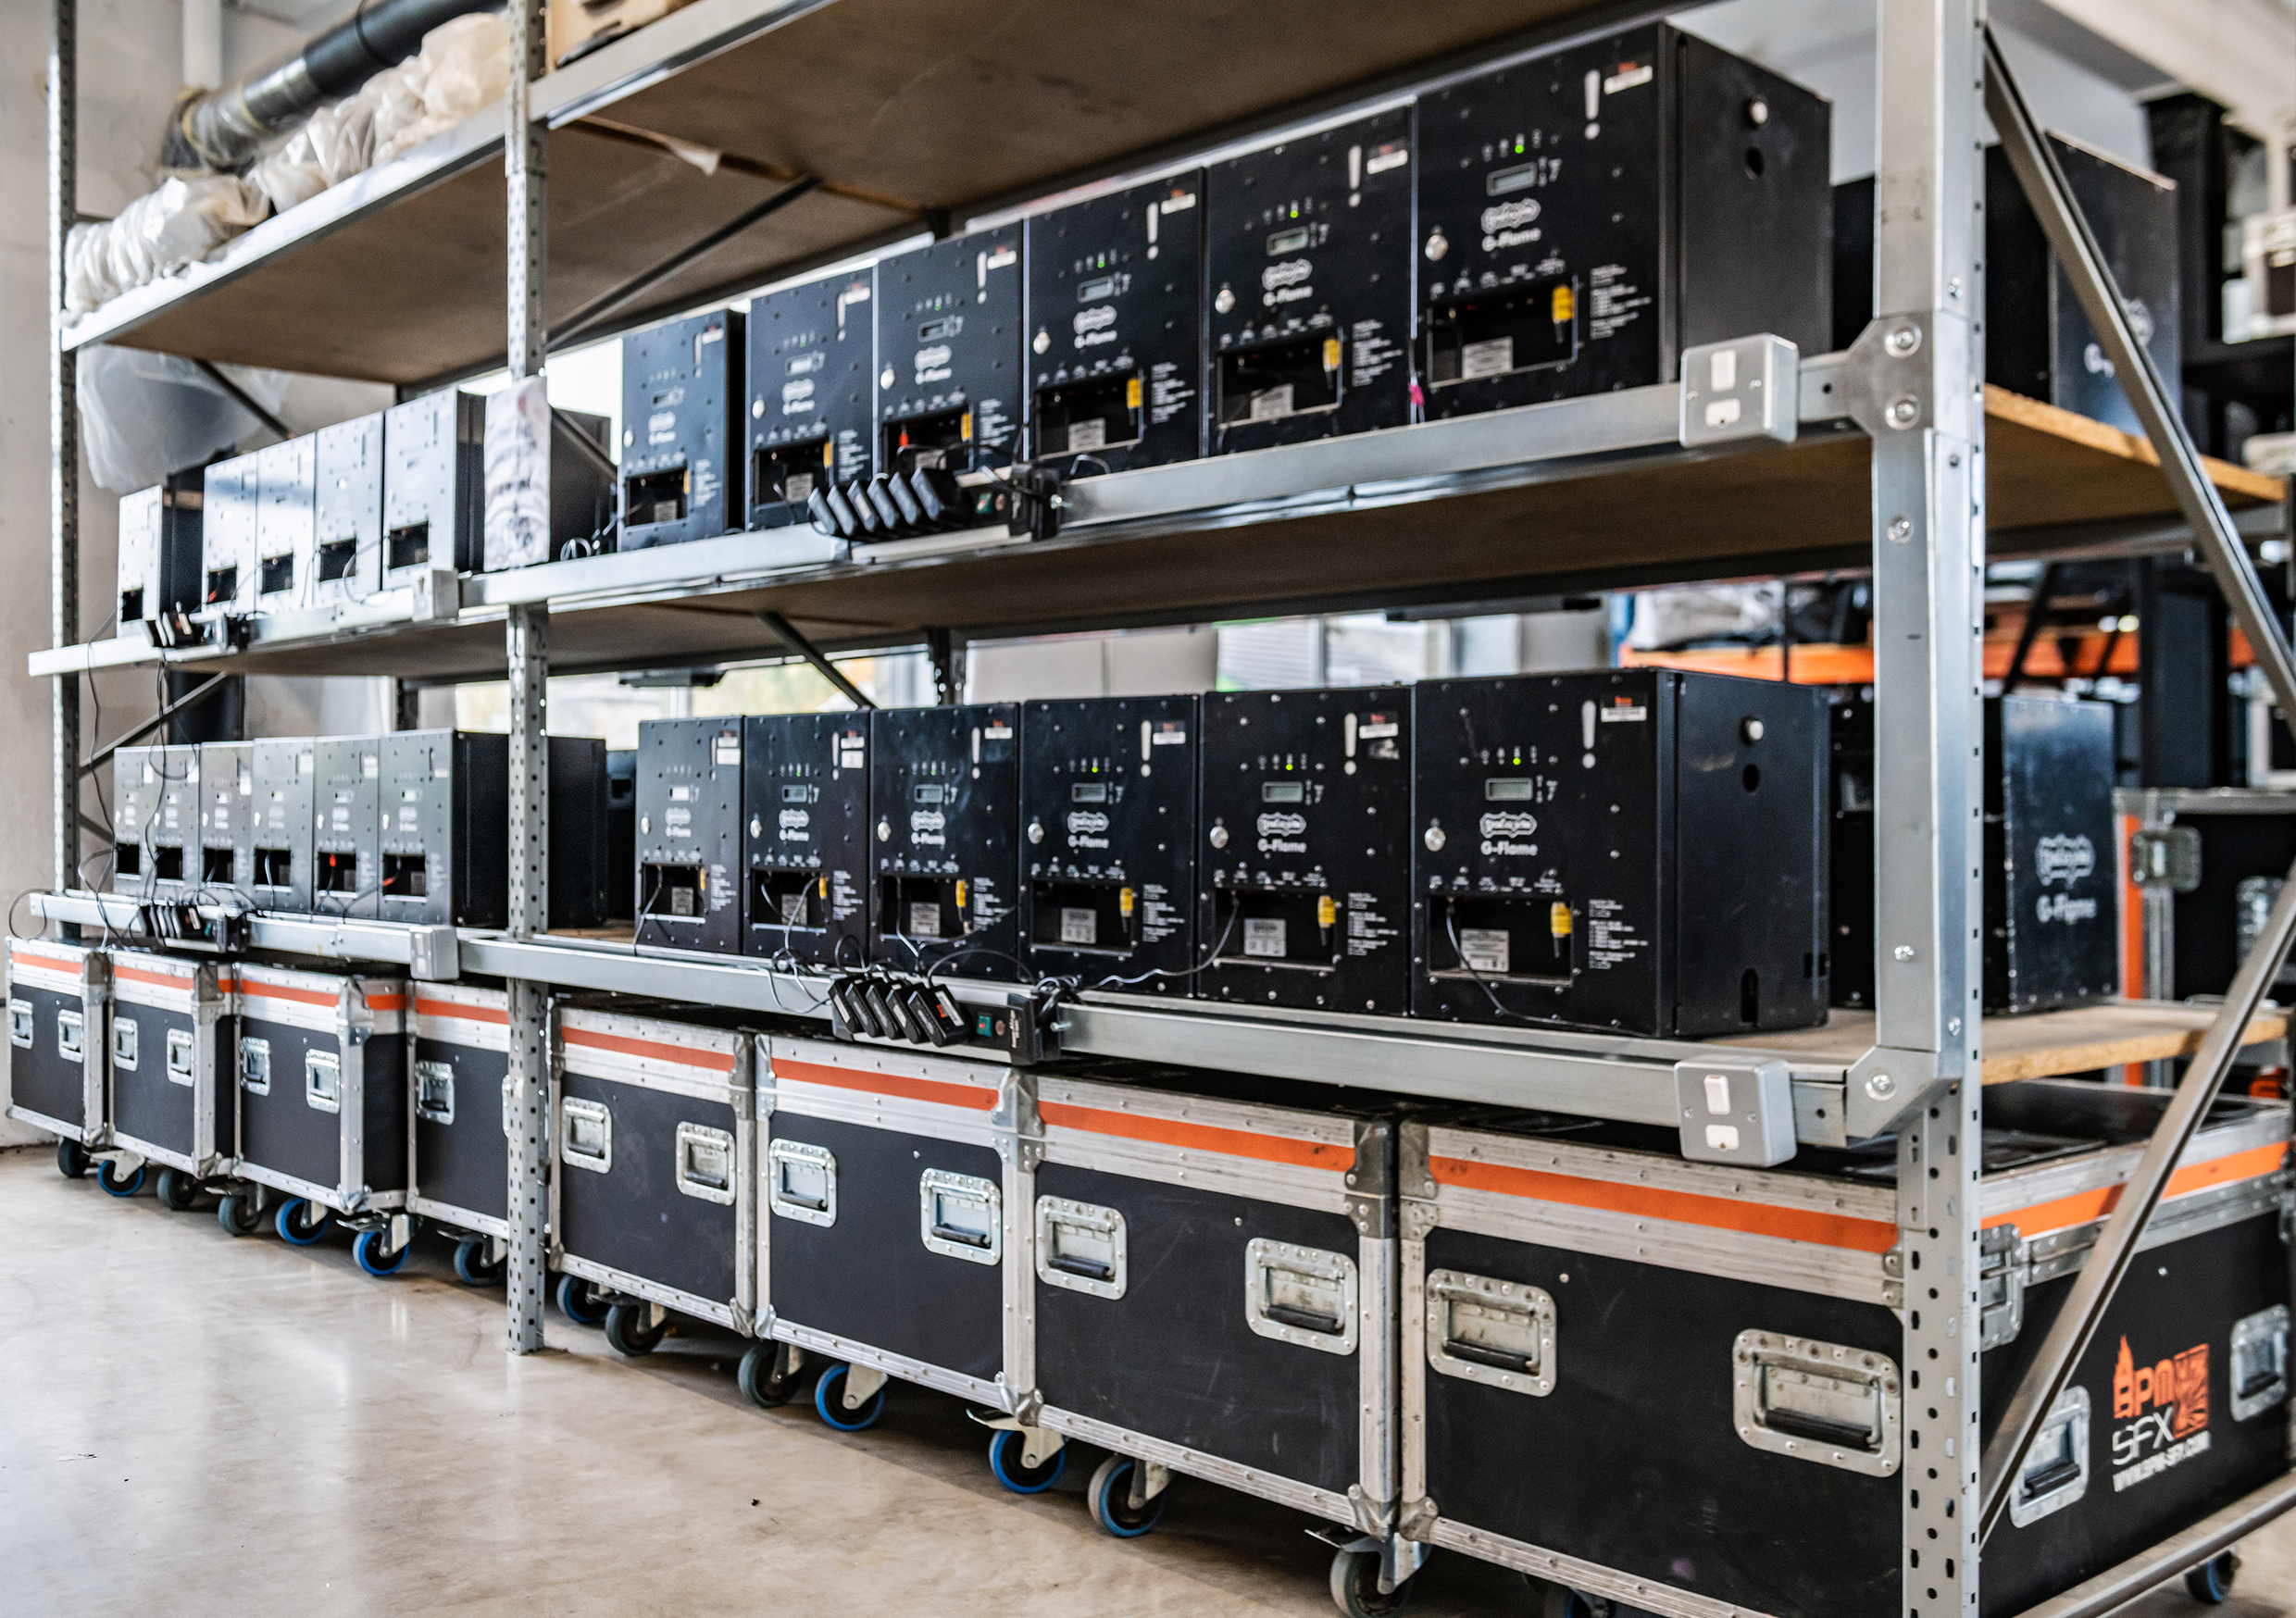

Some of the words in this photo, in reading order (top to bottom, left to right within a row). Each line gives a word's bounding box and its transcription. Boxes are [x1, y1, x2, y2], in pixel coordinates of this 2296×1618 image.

[1257, 838, 1307, 853] G-Flame
[1480, 840, 1539, 856] G-Flame
[2112, 1406, 2175, 1466] SFX
